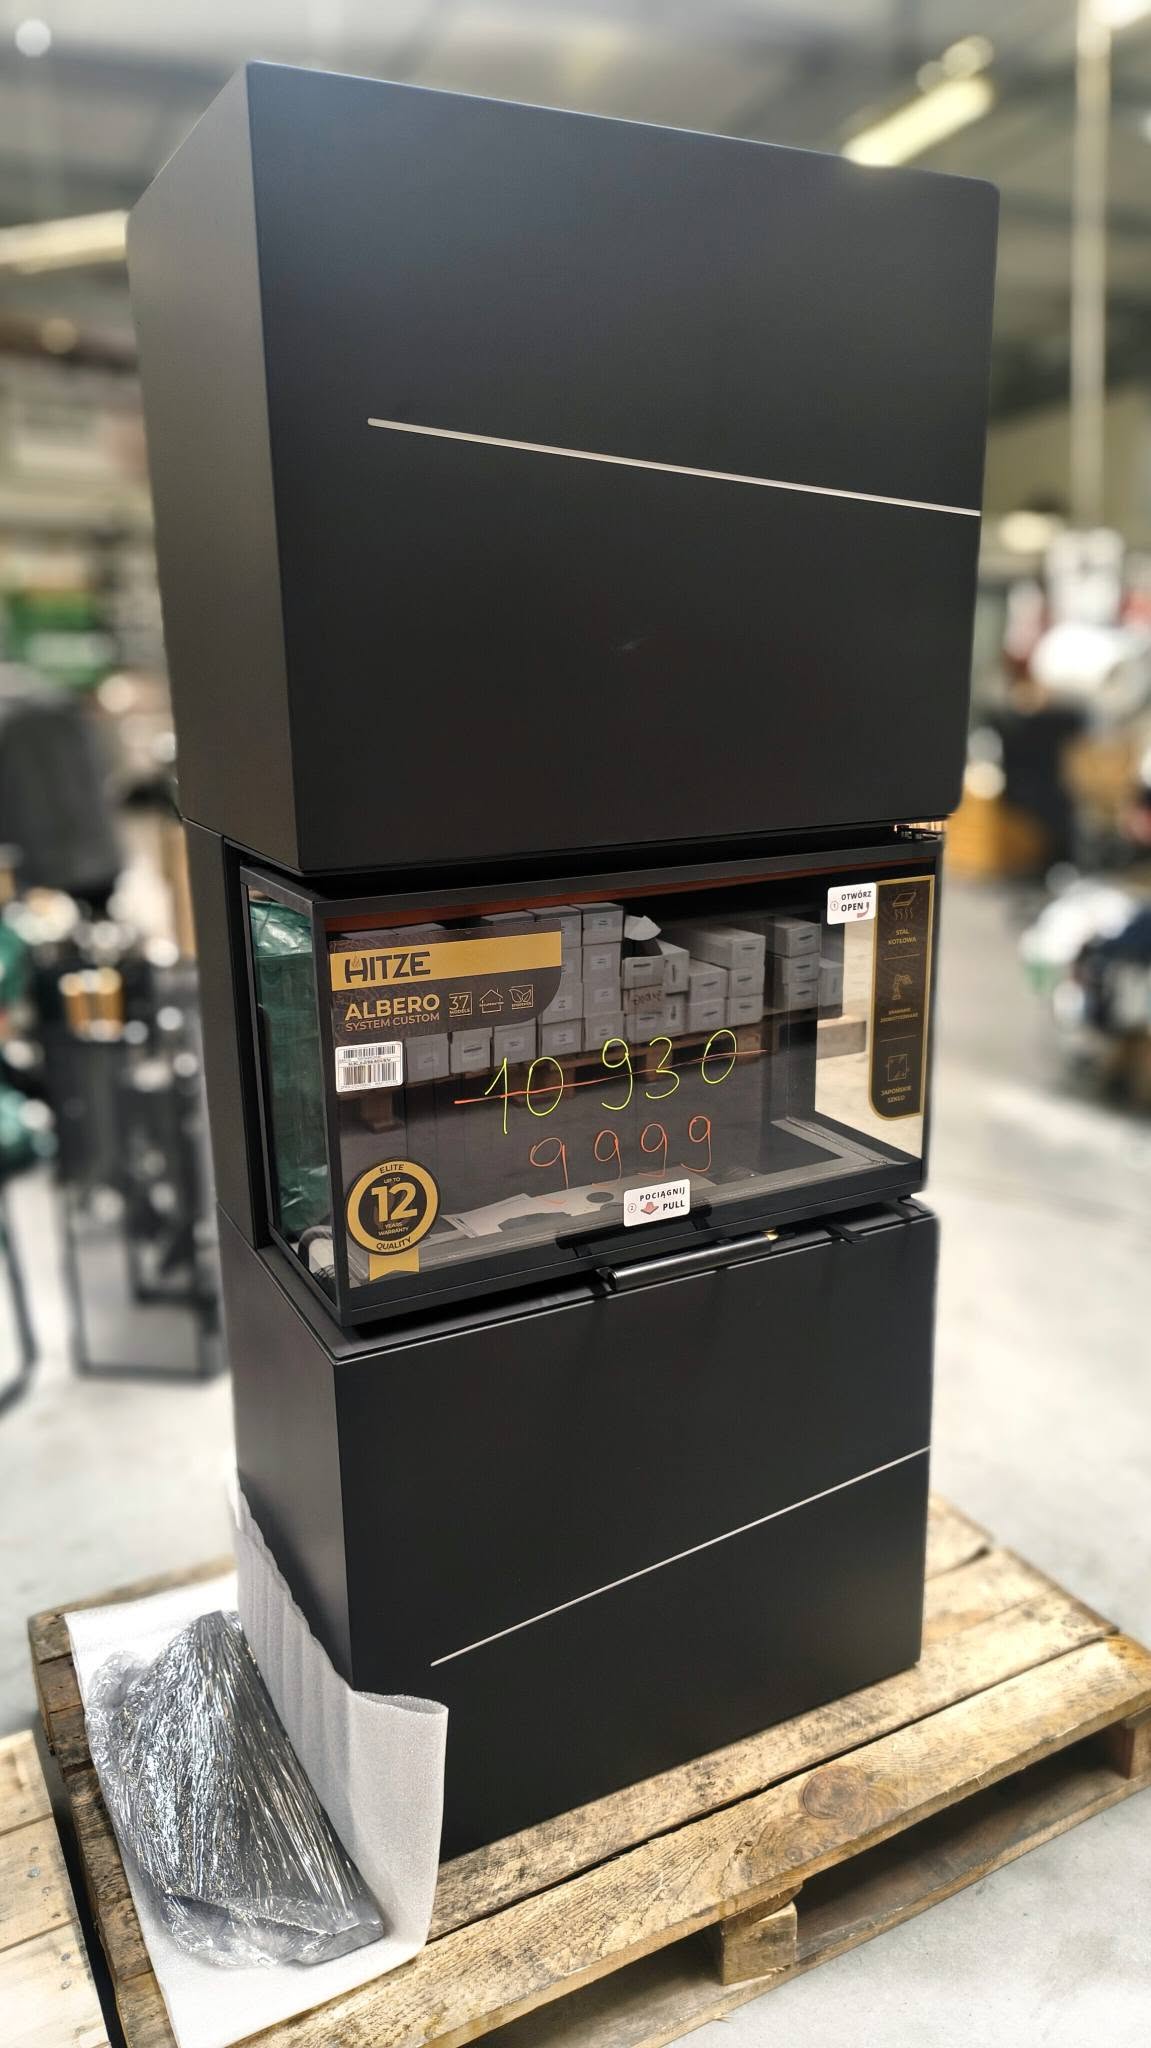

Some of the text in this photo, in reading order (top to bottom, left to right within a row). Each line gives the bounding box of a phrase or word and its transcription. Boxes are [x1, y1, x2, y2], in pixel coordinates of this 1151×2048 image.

[841, 890, 872, 900] OTWÓRZ
[841, 902, 864, 912] OPEN
[345, 951, 430, 983] HITZE
[345, 993, 440, 1021] ALBERO
[449, 994, 469, 1010] 37
[345, 1012, 440, 1032] SYSTEM CUSTOM
[380, 1164, 404, 1173] ELITE
[639, 1187, 685, 1202] POCIĄGNIJ
[371, 1182, 417, 1222] 12
[662, 1200, 685, 1211] PULL
[378, 1227, 409, 1236] WARRANTY
[384, 1222, 403, 1230] YEARS
[376, 1236, 411, 1250] QUALITY
